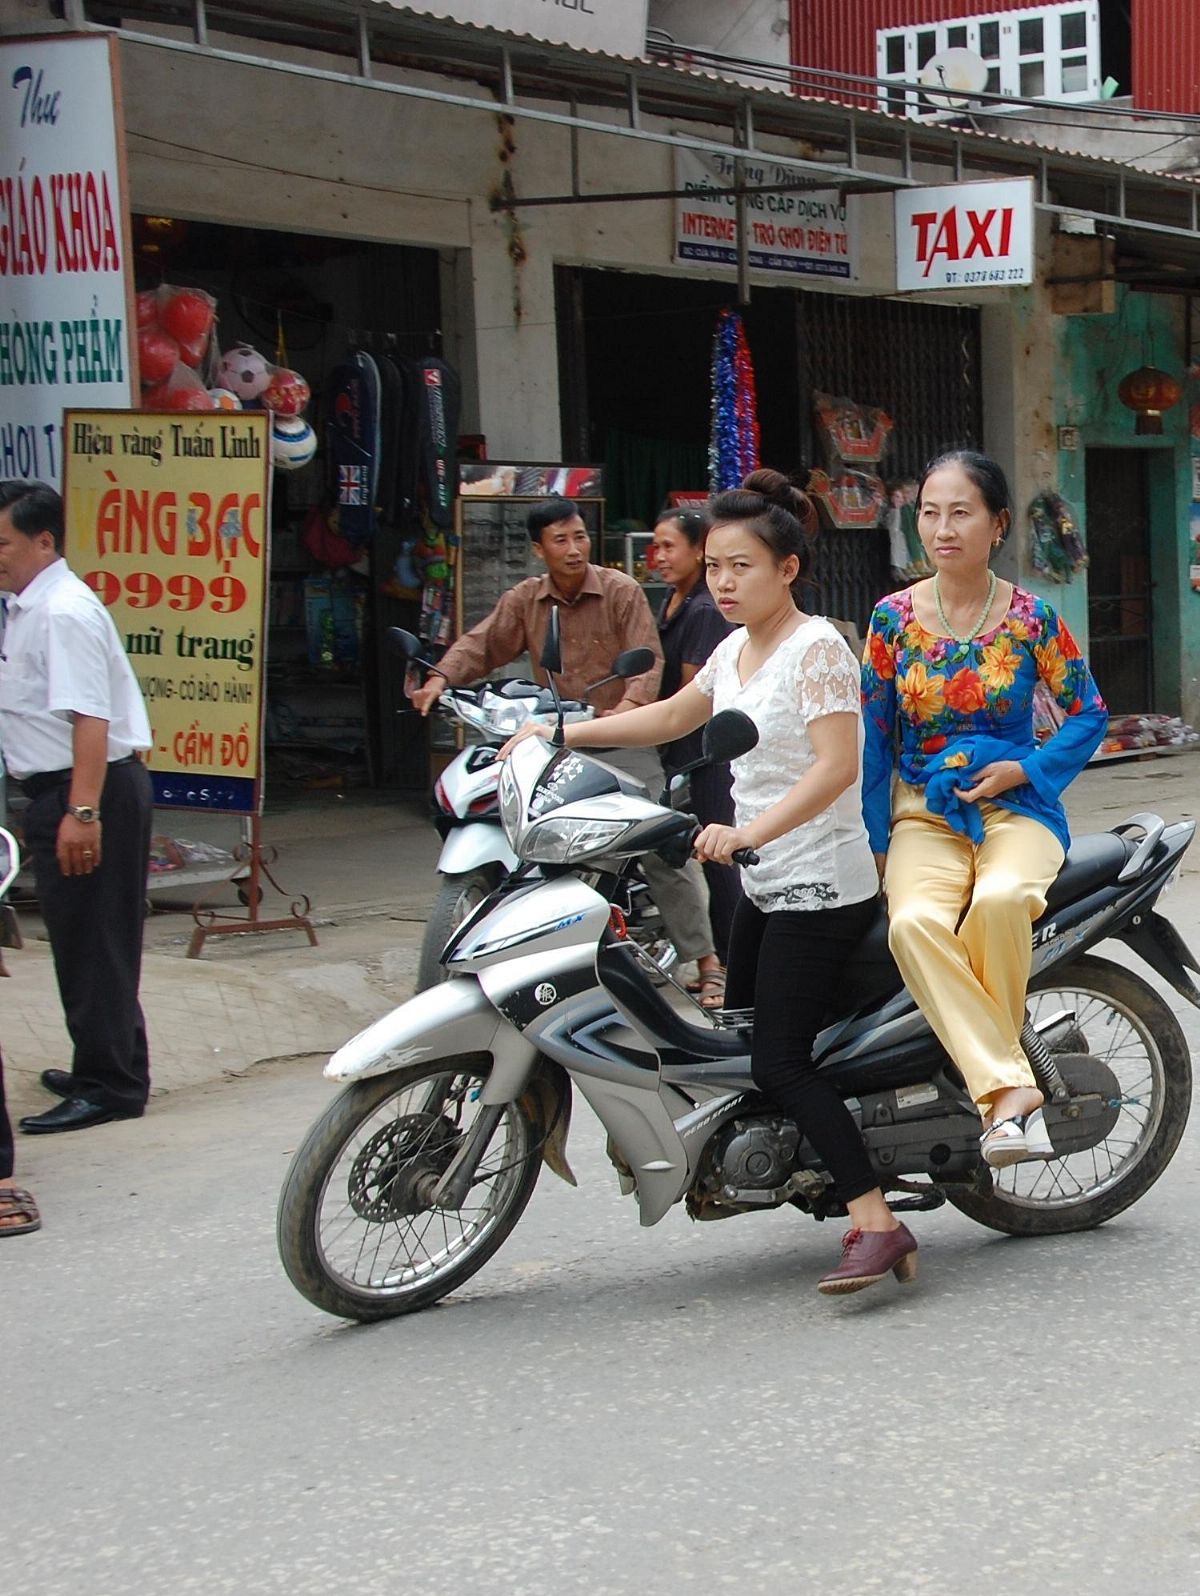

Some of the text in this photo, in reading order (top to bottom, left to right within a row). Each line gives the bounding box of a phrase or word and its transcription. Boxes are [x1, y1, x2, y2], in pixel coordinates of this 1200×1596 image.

[50, 170, 120, 274] KHOA
[682, 212, 737, 241] INTERNE
[911, 205, 1014, 277] TAXI
[60, 294, 123, 384] PHẨM
[121, 426, 163, 467] vàng
[170, 421, 215, 458] Tuấn
[187, 491, 261, 574] BẠC
[83, 571, 247, 614] 9999
[175, 625, 256, 672] trang
[223, 676, 254, 705] HÀNH
[219, 722, 249, 768] ĐỒ
